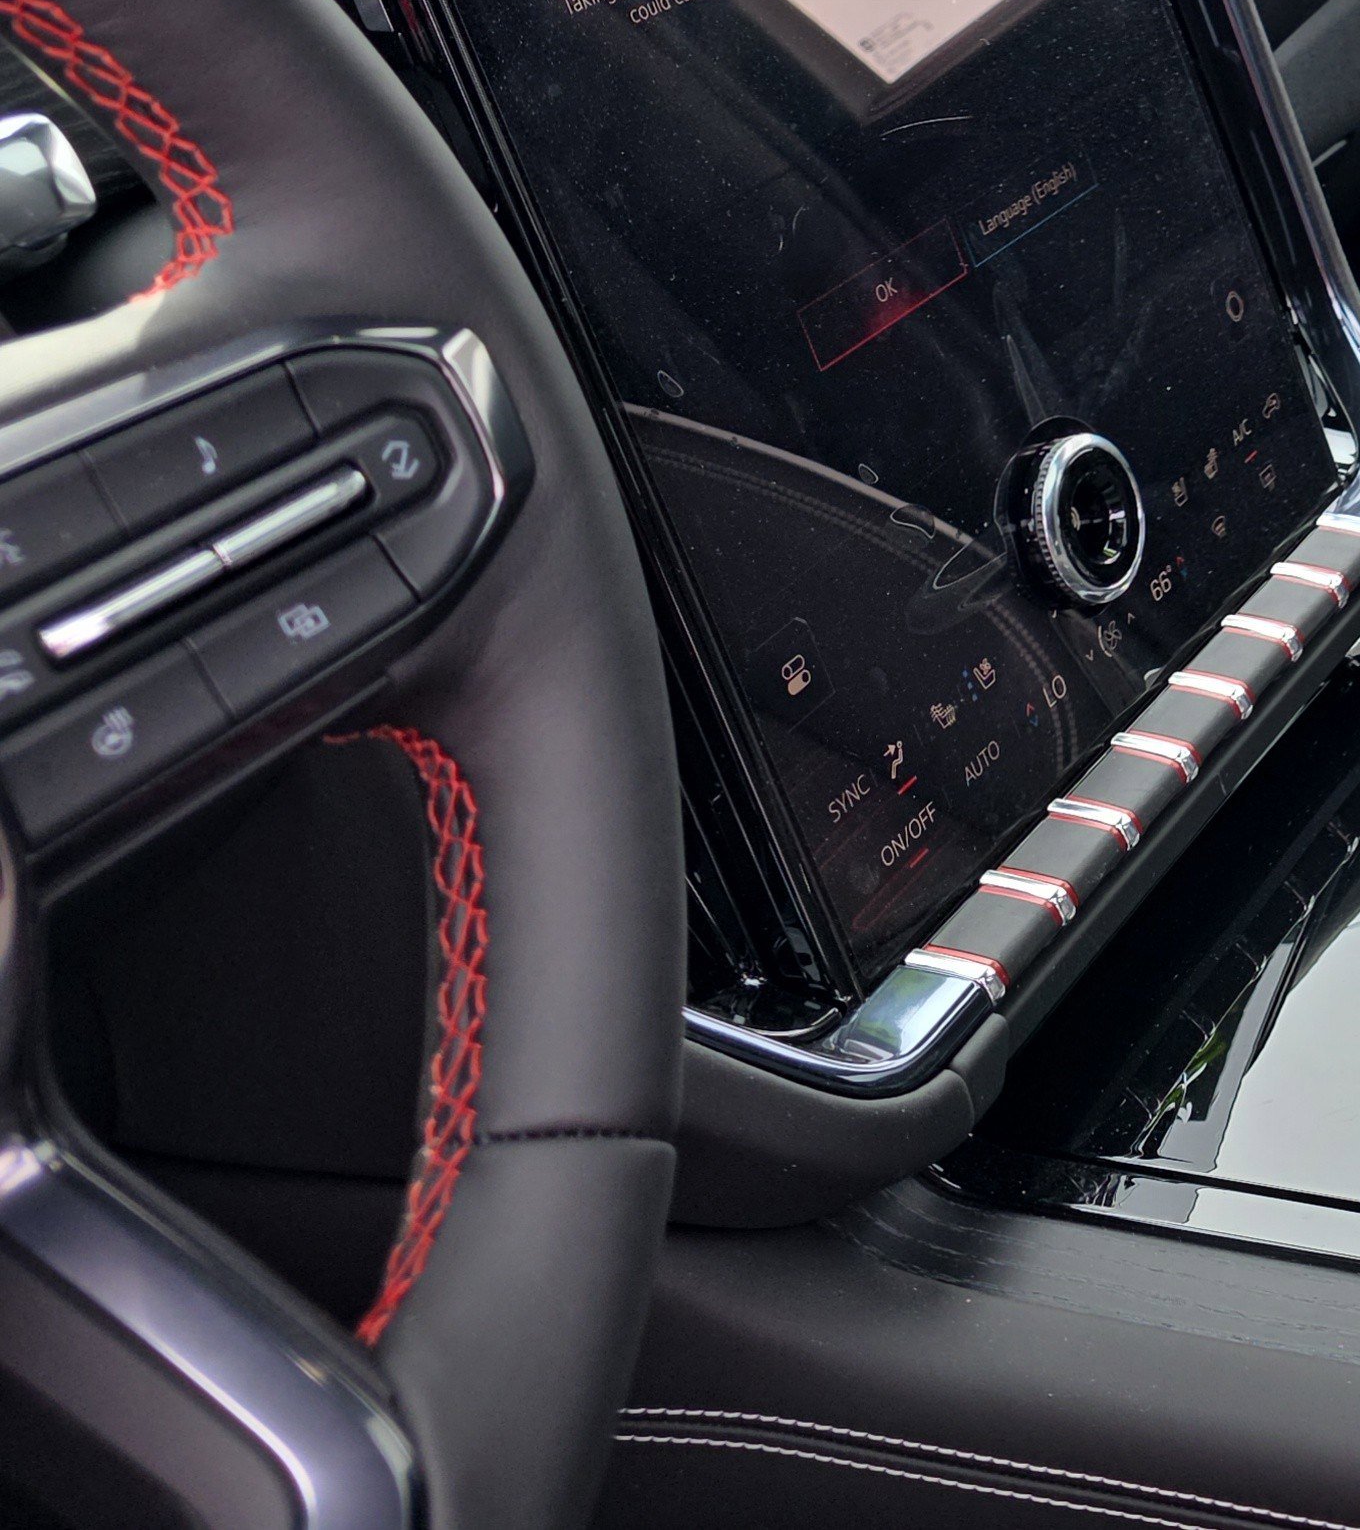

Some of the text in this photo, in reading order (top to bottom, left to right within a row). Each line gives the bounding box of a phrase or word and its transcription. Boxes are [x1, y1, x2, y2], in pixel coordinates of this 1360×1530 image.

[977, 160, 1079, 237] Language (English)
[874, 277, 899, 307] OK
[1230, 417, 1253, 449] A/C
[1043, 674, 1069, 711] LO
[963, 738, 1003, 787] AUTO
[826, 770, 874, 825] SYNC
[879, 802, 940, 867] ON/OFF
